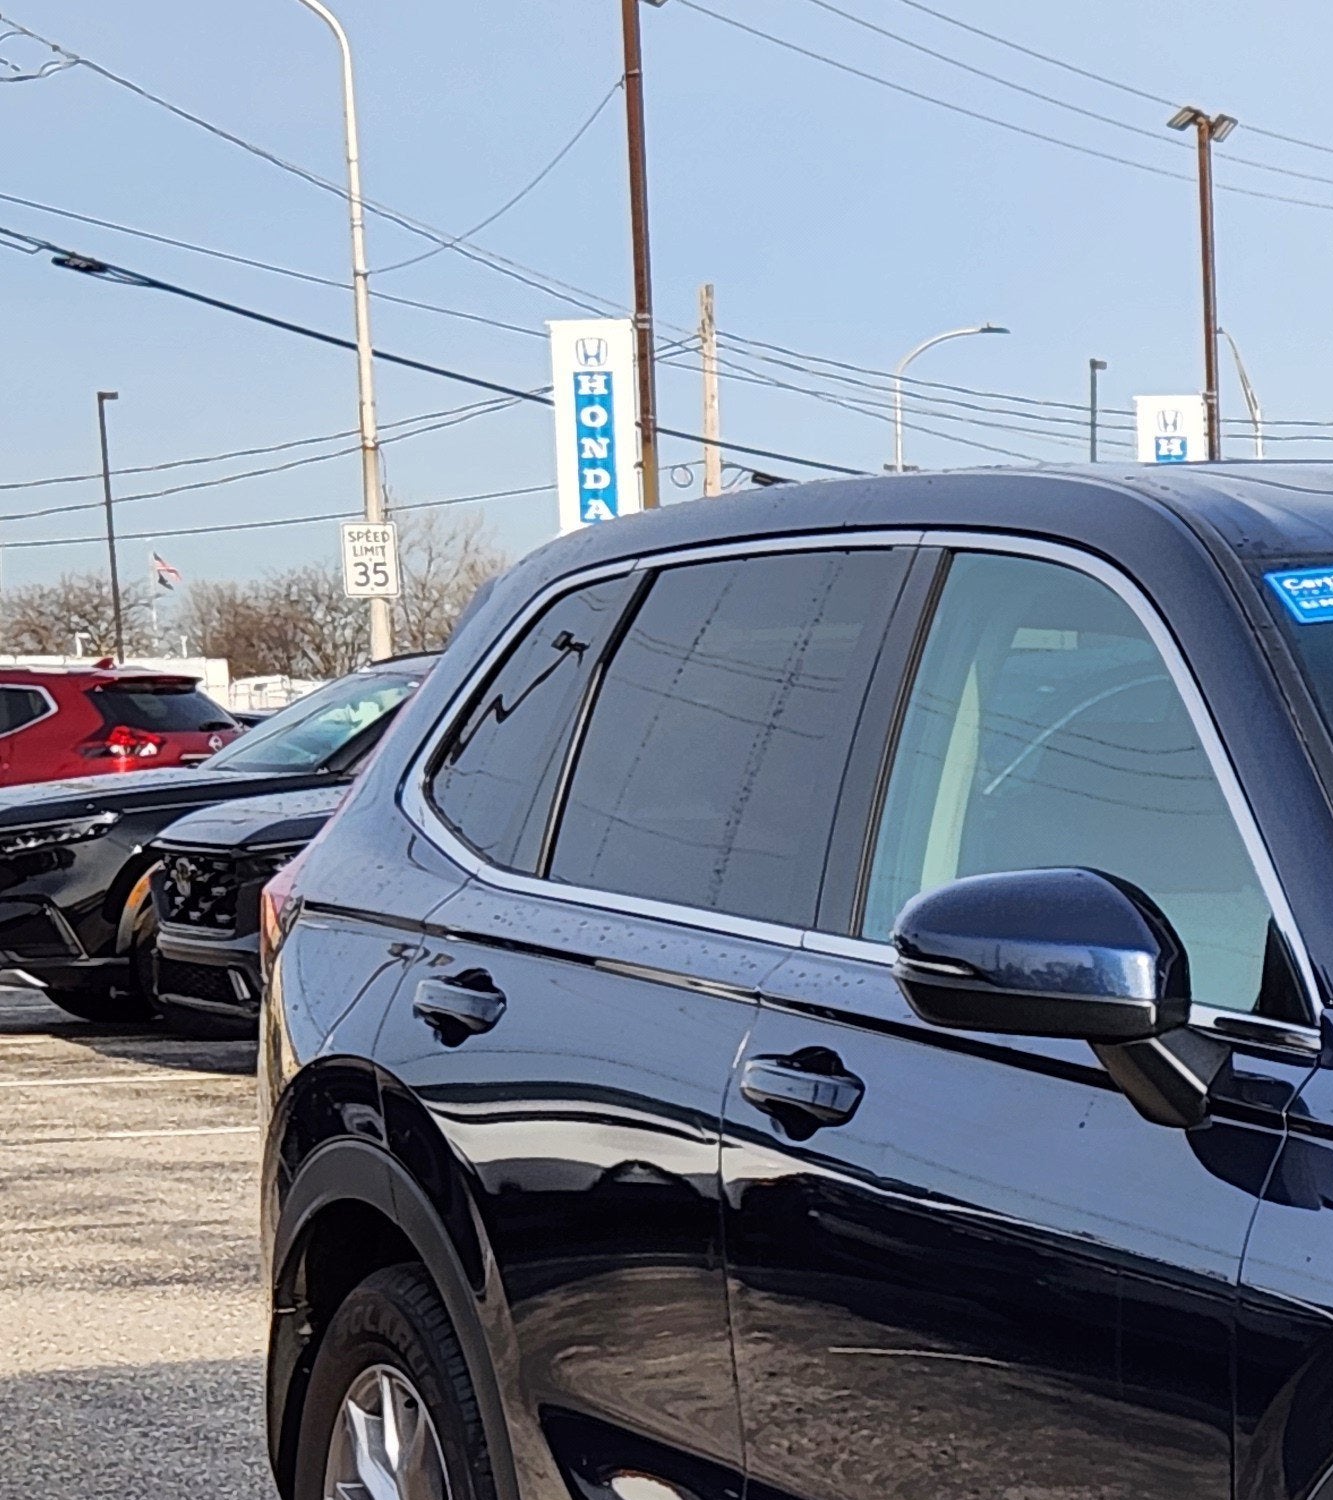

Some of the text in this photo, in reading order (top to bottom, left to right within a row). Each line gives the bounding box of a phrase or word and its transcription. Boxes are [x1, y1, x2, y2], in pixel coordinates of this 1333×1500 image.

[577, 375, 616, 520] HONDA
[348, 530, 390, 543] SPEED
[353, 545, 386, 557] LIMIT
[353, 562, 389, 587] 35
